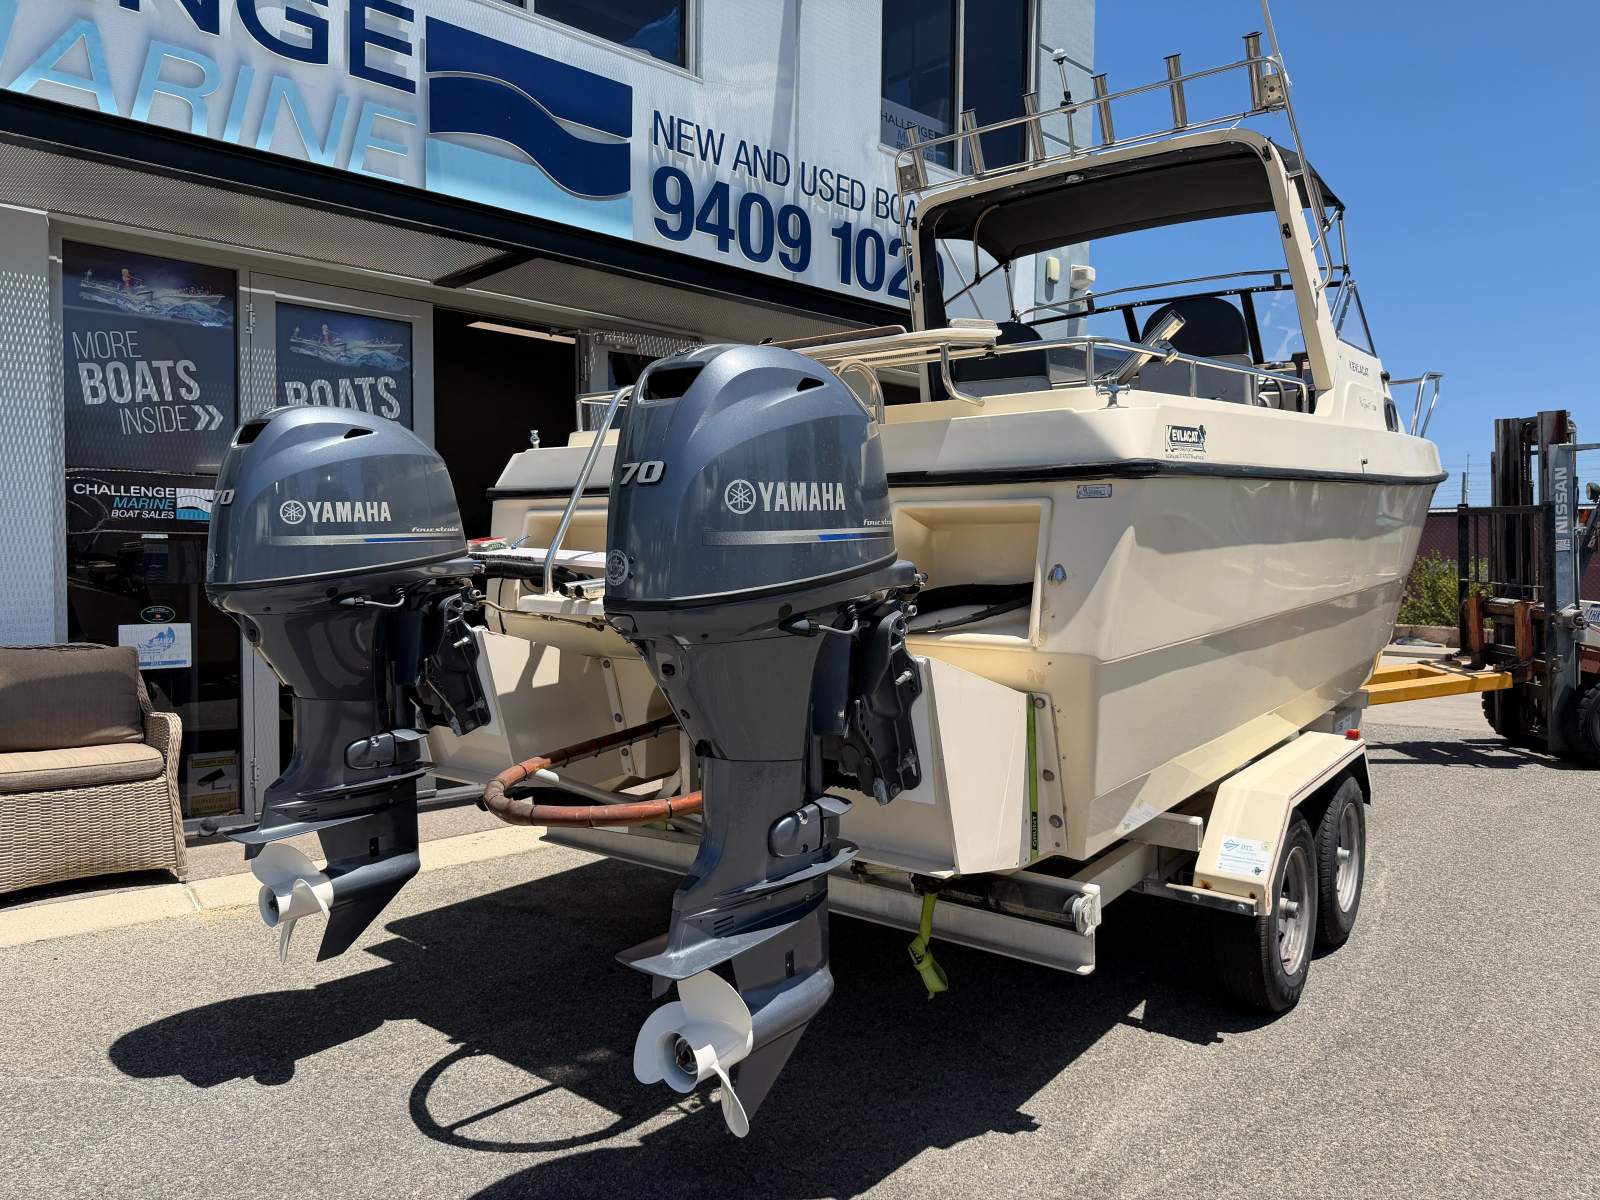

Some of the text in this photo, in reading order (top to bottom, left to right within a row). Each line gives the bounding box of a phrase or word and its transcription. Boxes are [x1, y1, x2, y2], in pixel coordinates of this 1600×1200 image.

[653, 110, 725, 166] NEW
[732, 139, 791, 187] AND
[799, 161, 866, 212] USED
[653, 166, 944, 300] 9409 102
[72, 331, 142, 359] MORE
[78, 360, 201, 405] BOATS
[119, 405, 191, 435] INSIDE
[618, 460, 664, 485] 70
[73, 483, 176, 498] CHALLENGE
[113, 497, 175, 510] MARINE
[758, 482, 846, 512] YAMAHA
[1555, 467, 1568, 533] NISSAN
[111, 509, 174, 519] BOAT SALES
[307, 501, 392, 523] YAMAHA
